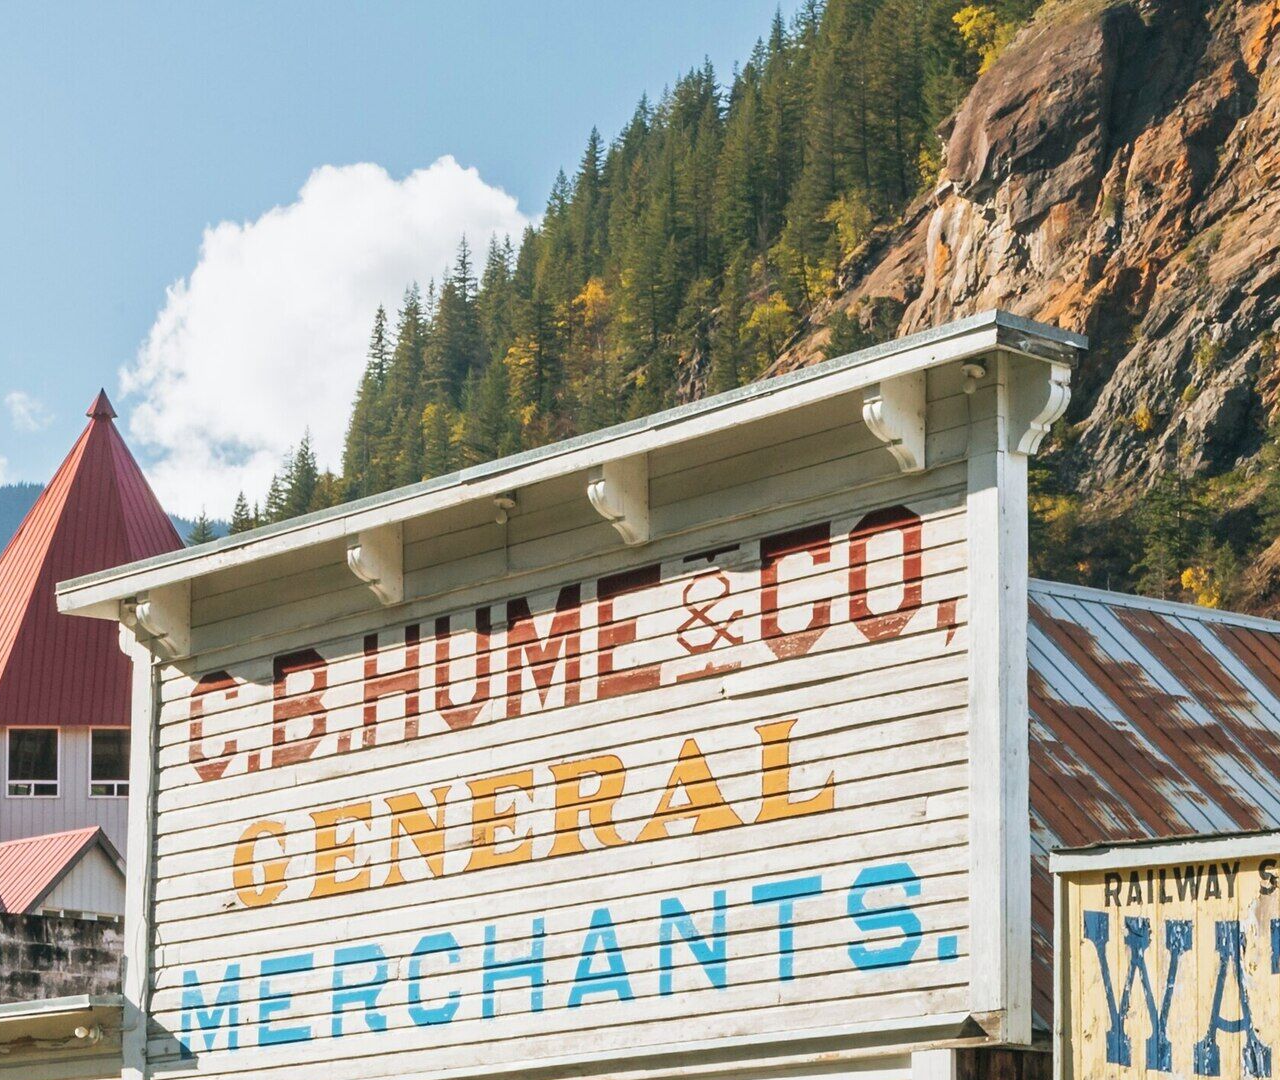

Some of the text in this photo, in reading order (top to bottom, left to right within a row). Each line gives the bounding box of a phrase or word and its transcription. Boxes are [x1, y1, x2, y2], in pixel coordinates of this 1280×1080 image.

[675, 565, 744, 658] &
[233, 718, 835, 908] GENERAL
[1103, 860, 1241, 908] RAILWAY
[180, 862, 959, 1061] MERCHANTS.
